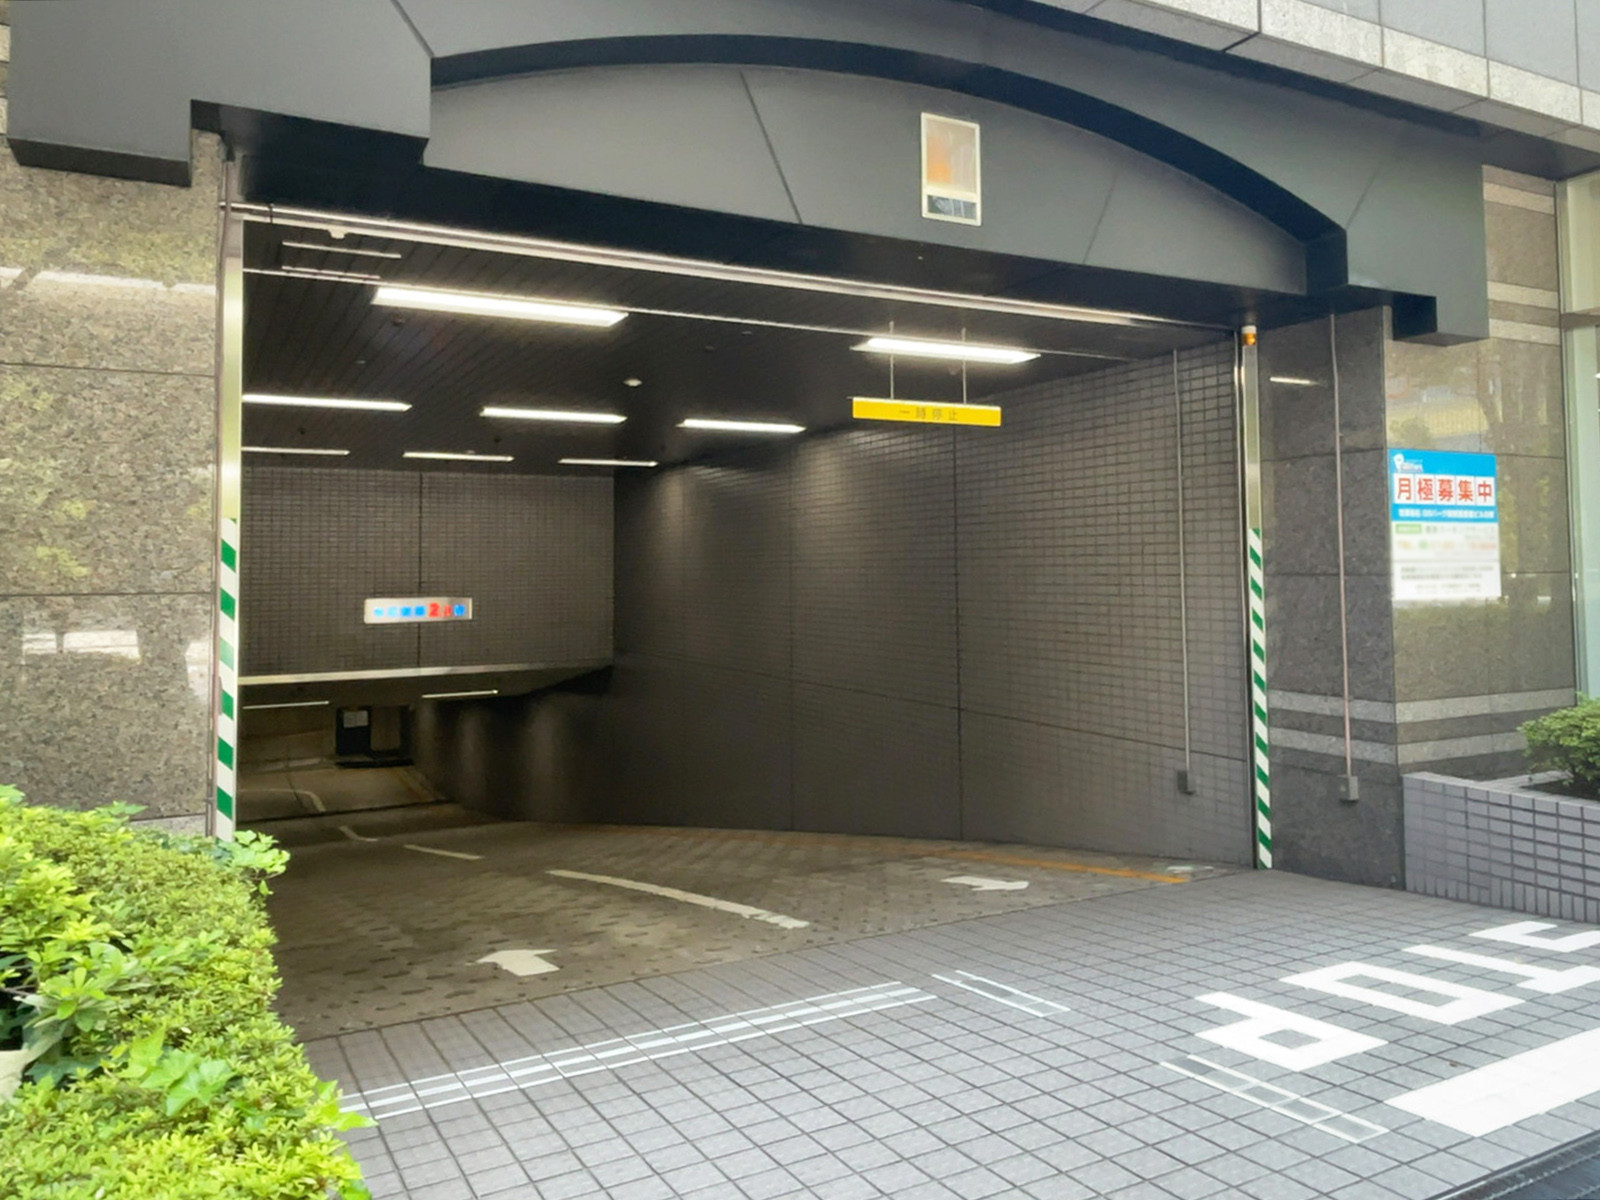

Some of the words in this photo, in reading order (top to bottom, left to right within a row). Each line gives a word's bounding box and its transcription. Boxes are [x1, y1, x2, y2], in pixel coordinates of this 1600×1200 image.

[1397, 478, 1492, 502] 月極募集中
